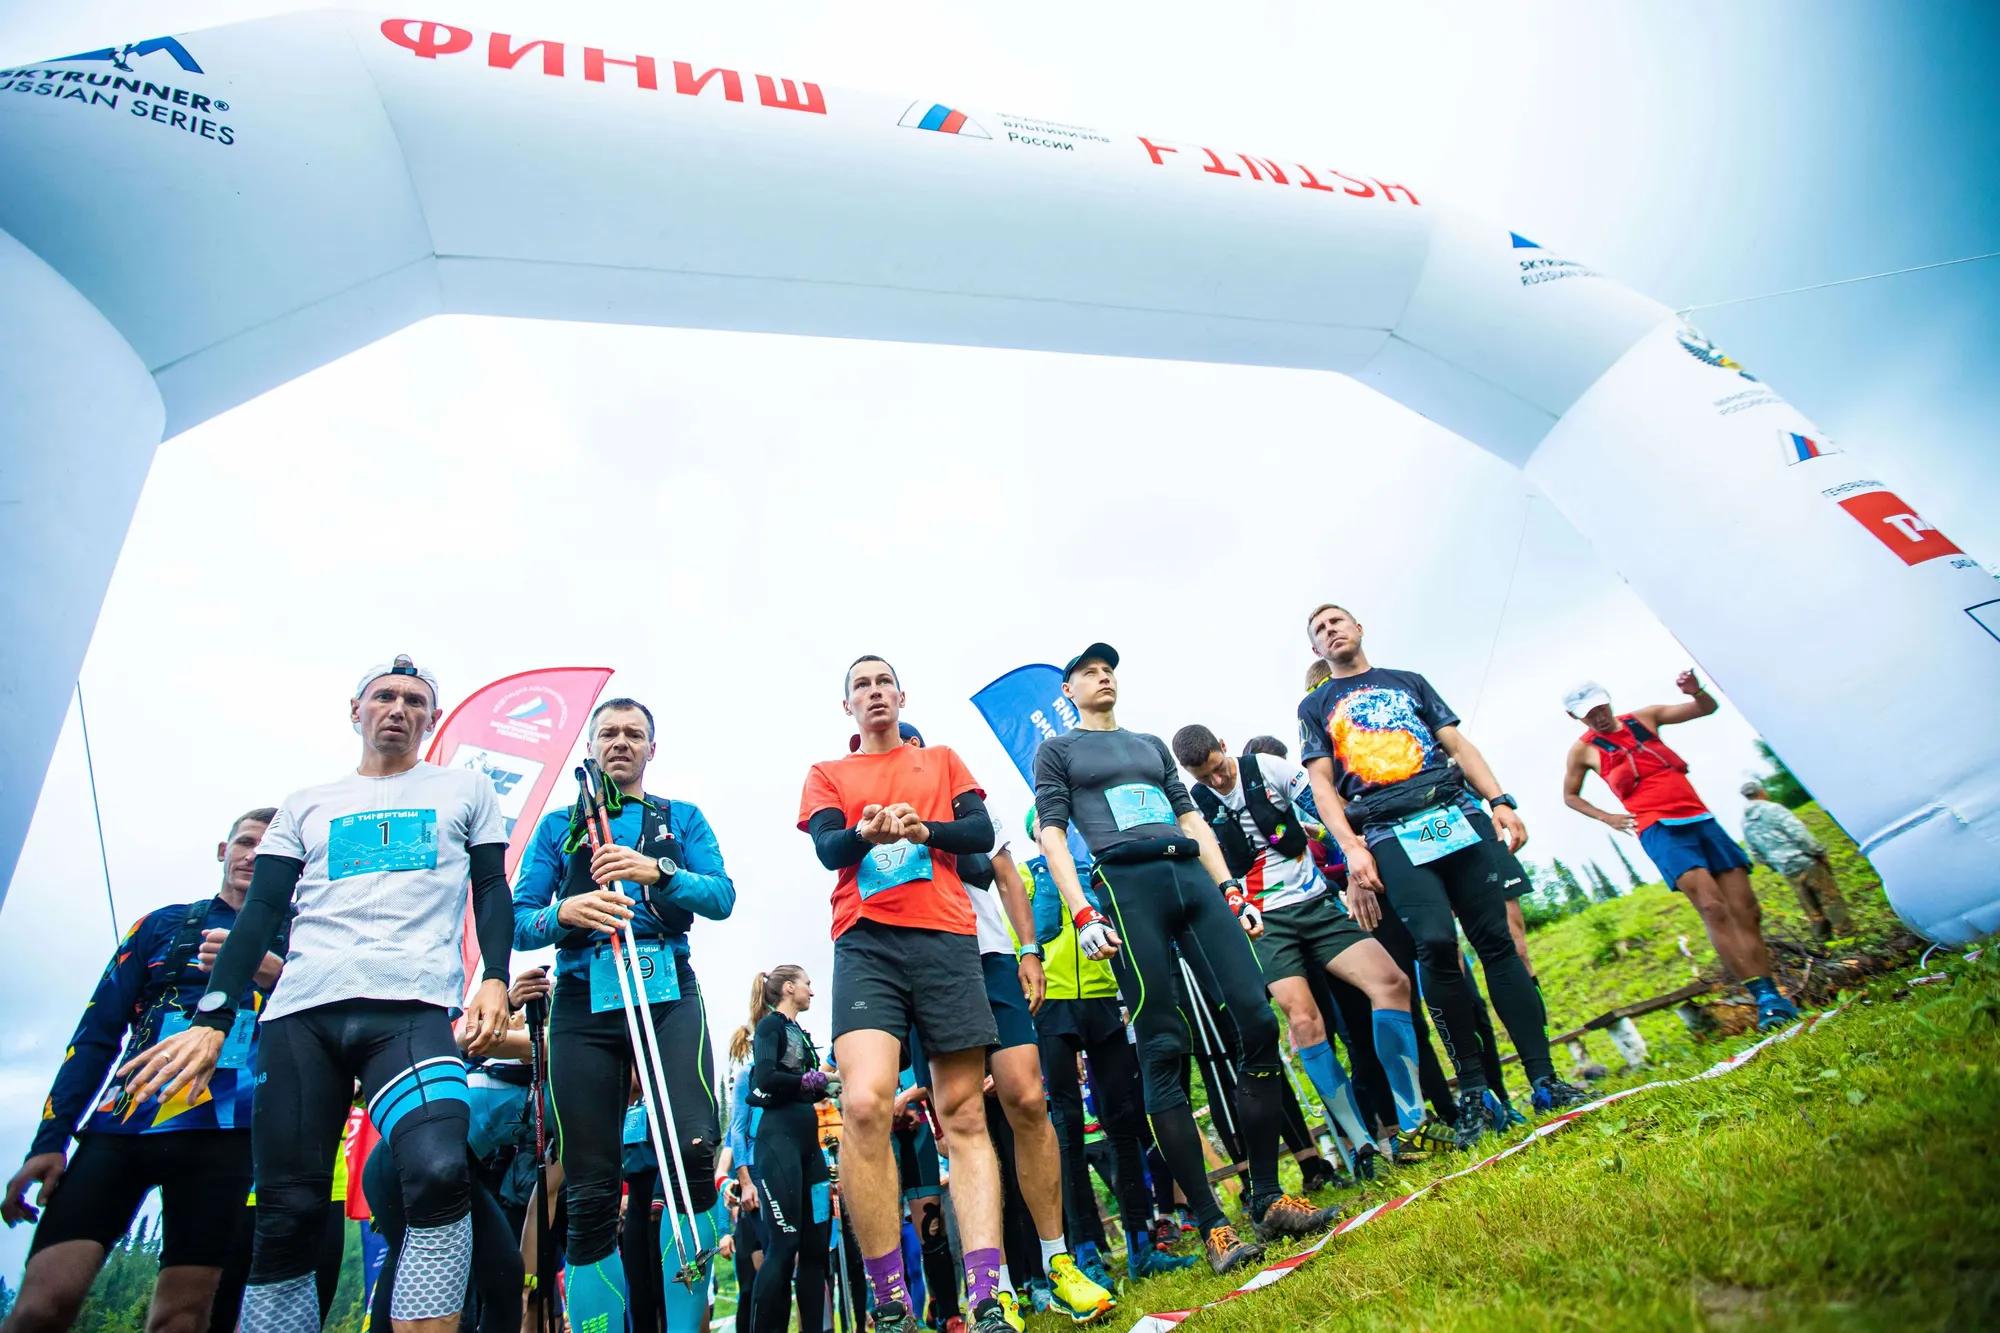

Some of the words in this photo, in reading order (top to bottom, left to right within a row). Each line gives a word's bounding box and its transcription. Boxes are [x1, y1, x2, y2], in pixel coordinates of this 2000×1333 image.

[380, 18, 828, 115] ФИНИШ
[130, 99, 236, 146] SERIES
[1008, 131, 1075, 152] России
[1132, 789, 1146, 808] 7
[377, 820, 390, 847] 1
[1419, 819, 1453, 843] 48
[874, 846, 908, 872] 37
